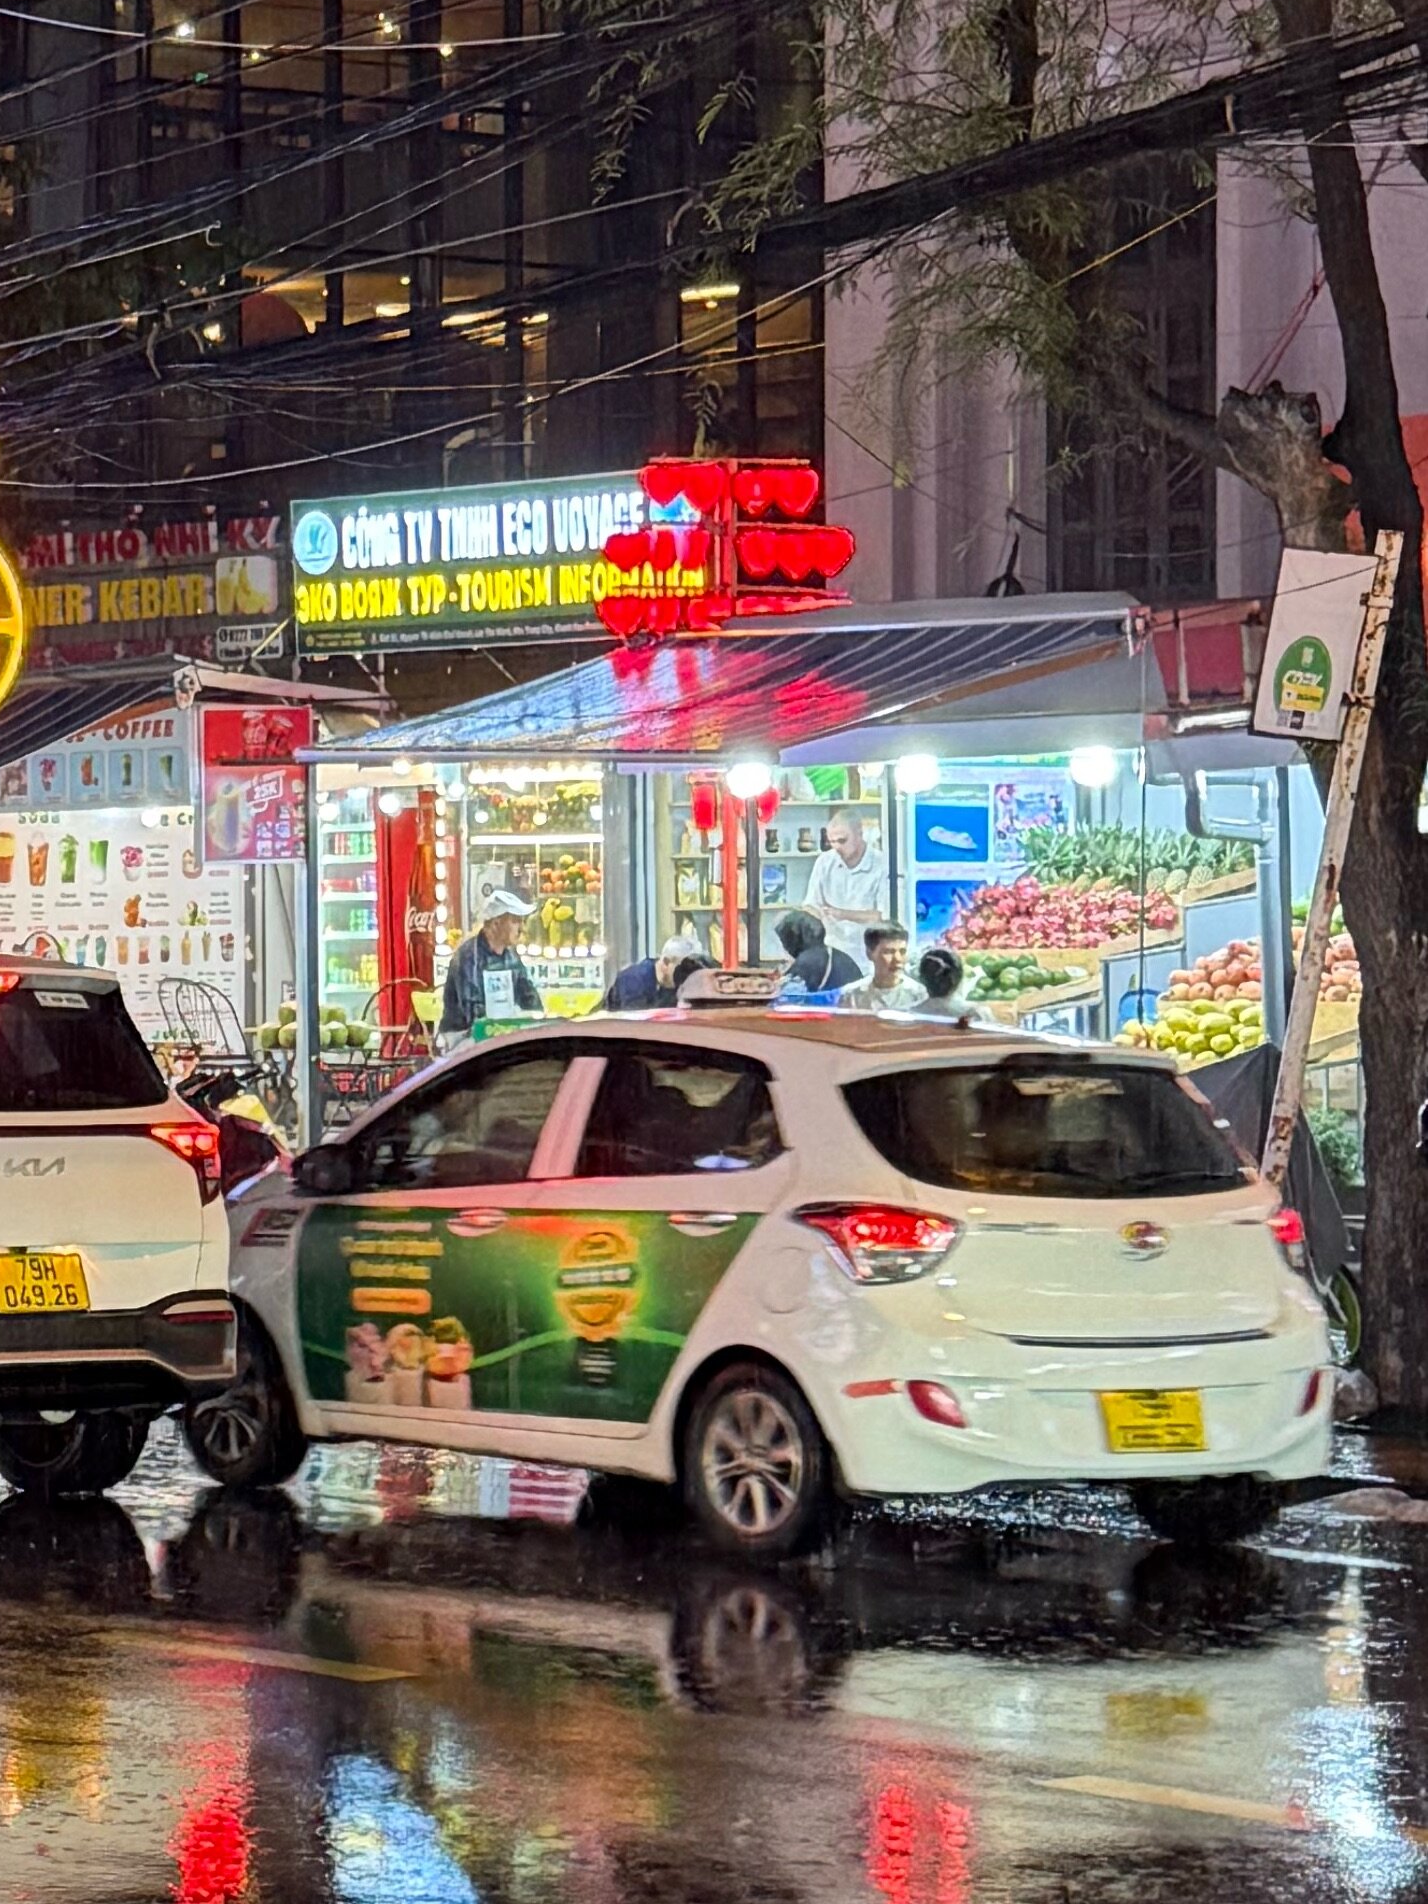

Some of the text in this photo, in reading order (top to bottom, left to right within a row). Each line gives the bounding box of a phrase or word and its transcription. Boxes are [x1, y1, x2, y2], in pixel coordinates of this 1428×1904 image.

[403, 509, 433, 565] TY
[437, 503, 499, 562] TNHH
[502, 499, 548, 556] ECO
[296, 582, 337, 624] ЭКО
[340, 577, 402, 621] ВОЯЖ
[102, 719, 175, 741] COFFEE
[14, 1258, 57, 1281] 79H
[4, 1283, 79, 1308] 049.26
